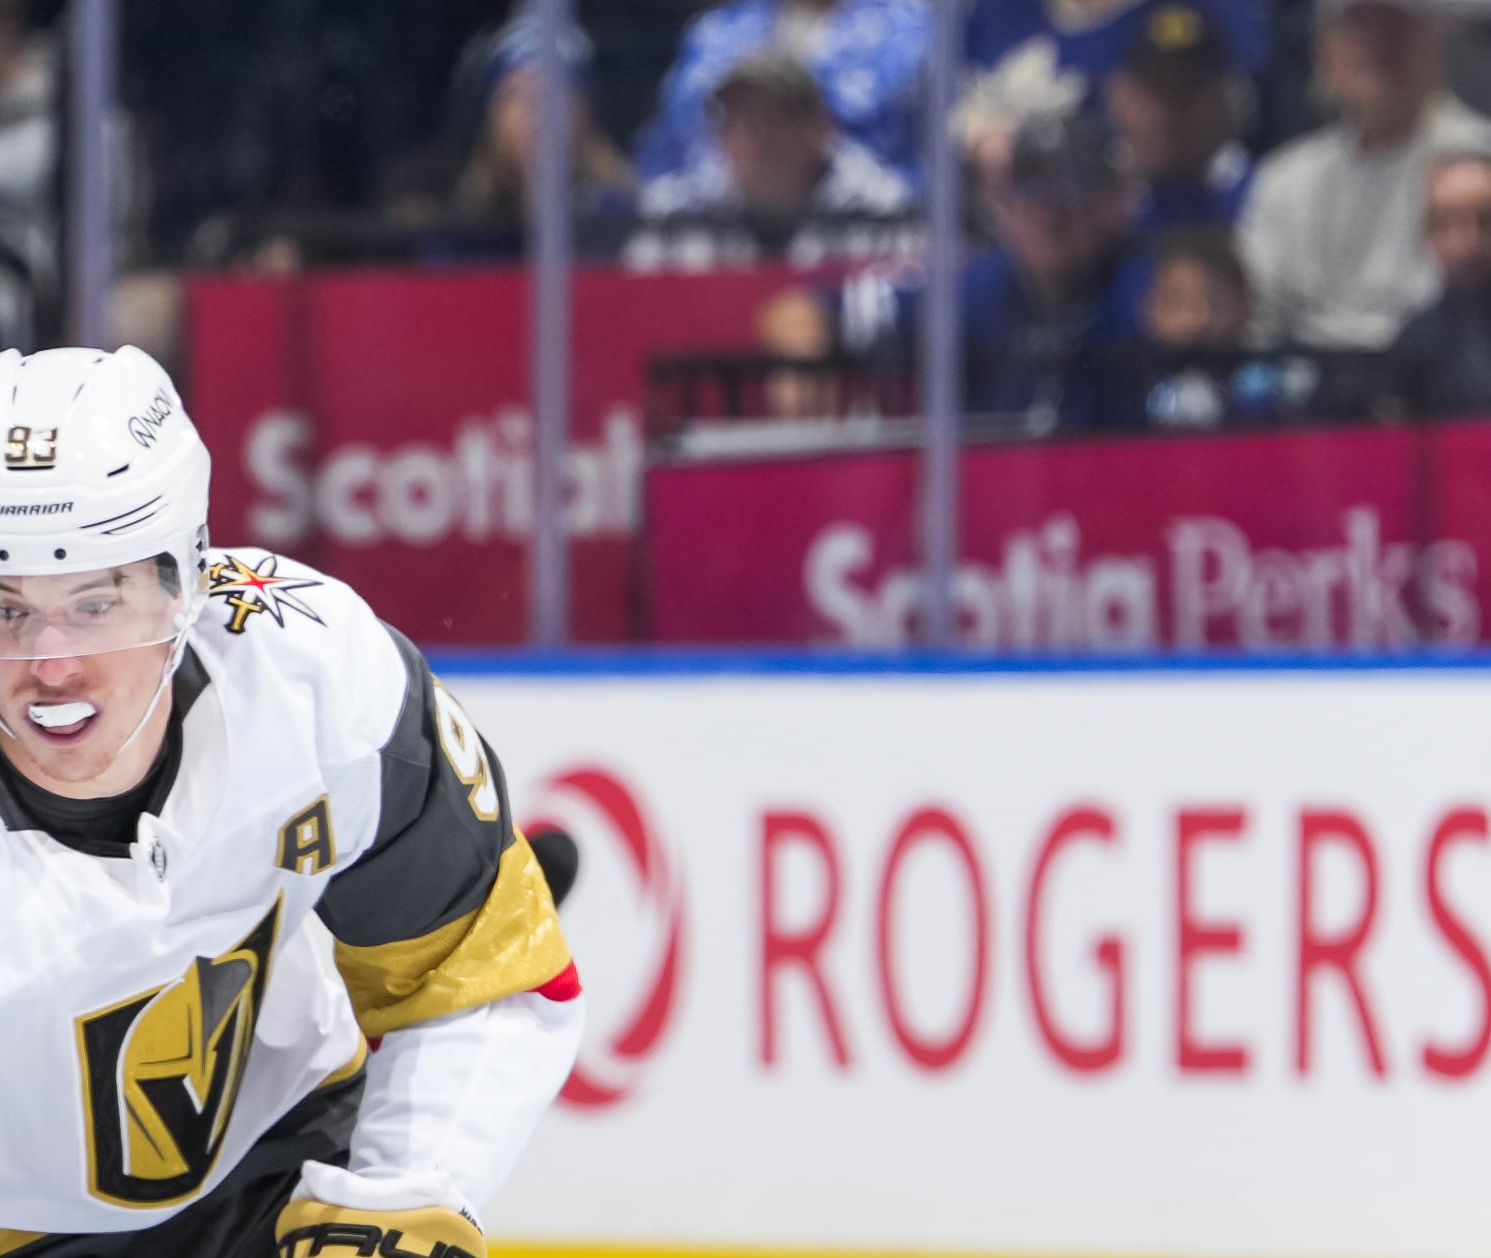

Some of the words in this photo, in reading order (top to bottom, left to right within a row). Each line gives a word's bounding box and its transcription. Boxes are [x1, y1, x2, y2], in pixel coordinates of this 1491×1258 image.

[4, 424, 60, 469] 93
[275, 794, 337, 876] A
[757, 803, 1491, 1083] ROGERS
